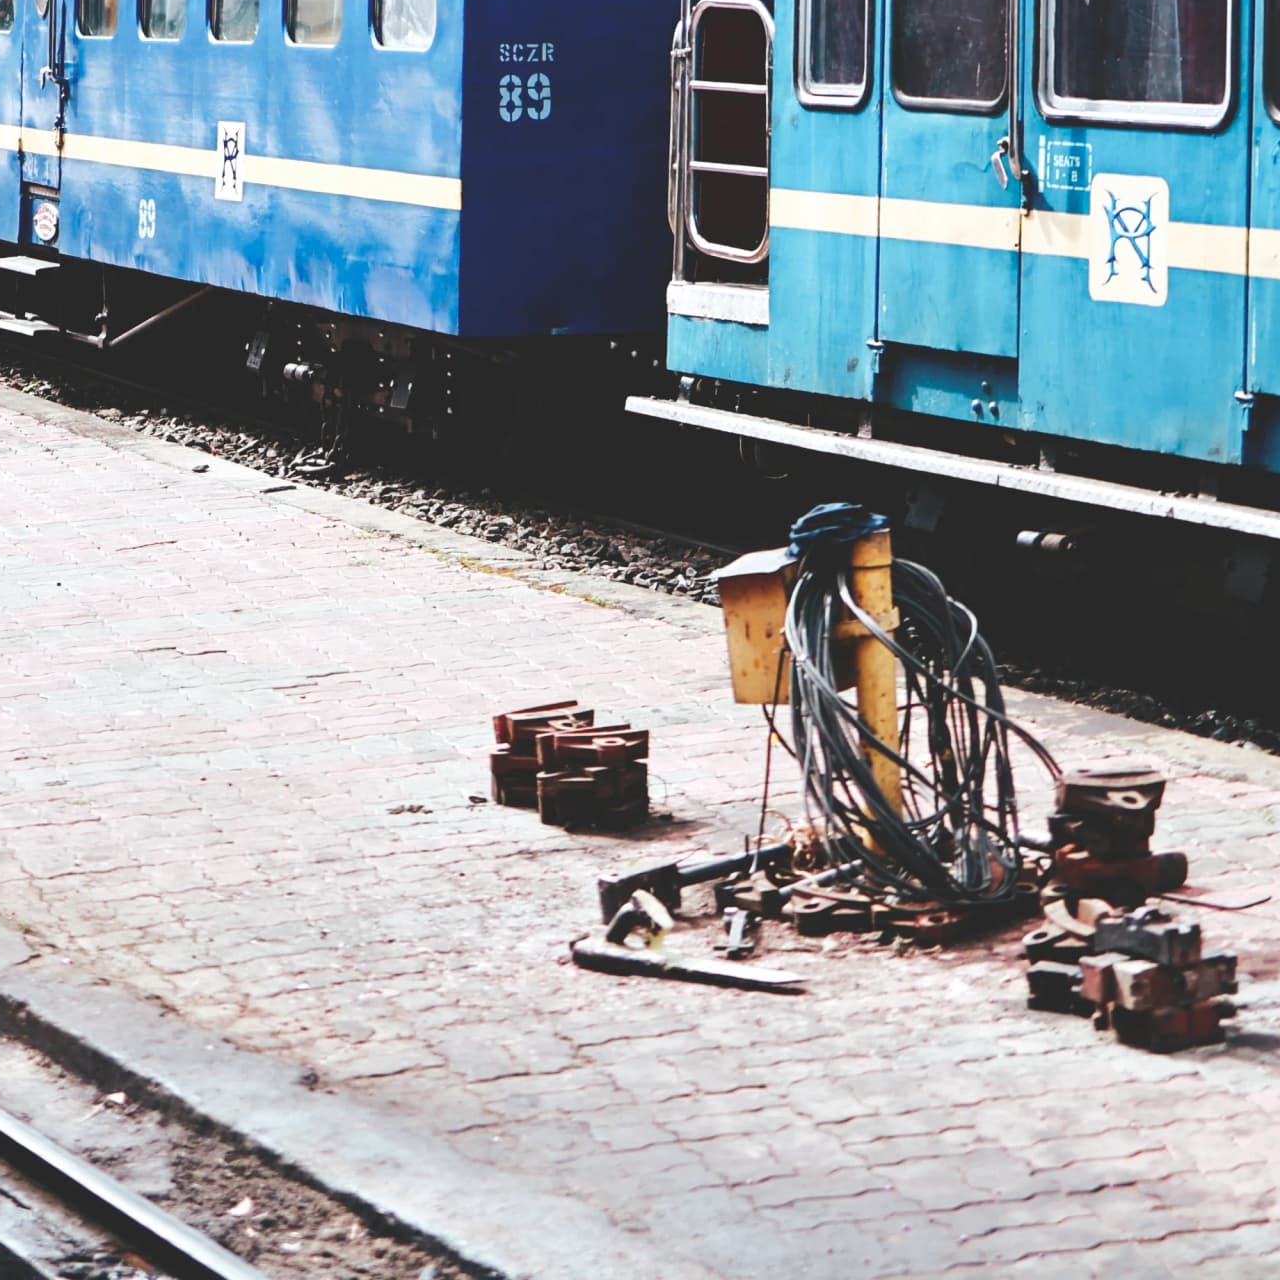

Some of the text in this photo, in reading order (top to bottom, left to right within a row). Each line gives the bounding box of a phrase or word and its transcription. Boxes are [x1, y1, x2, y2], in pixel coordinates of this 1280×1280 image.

[499, 42, 554, 62] SCZR
[499, 72, 551, 122] 89
[1053, 155, 1080, 168] SEATS
[138, 198, 157, 239] 89
